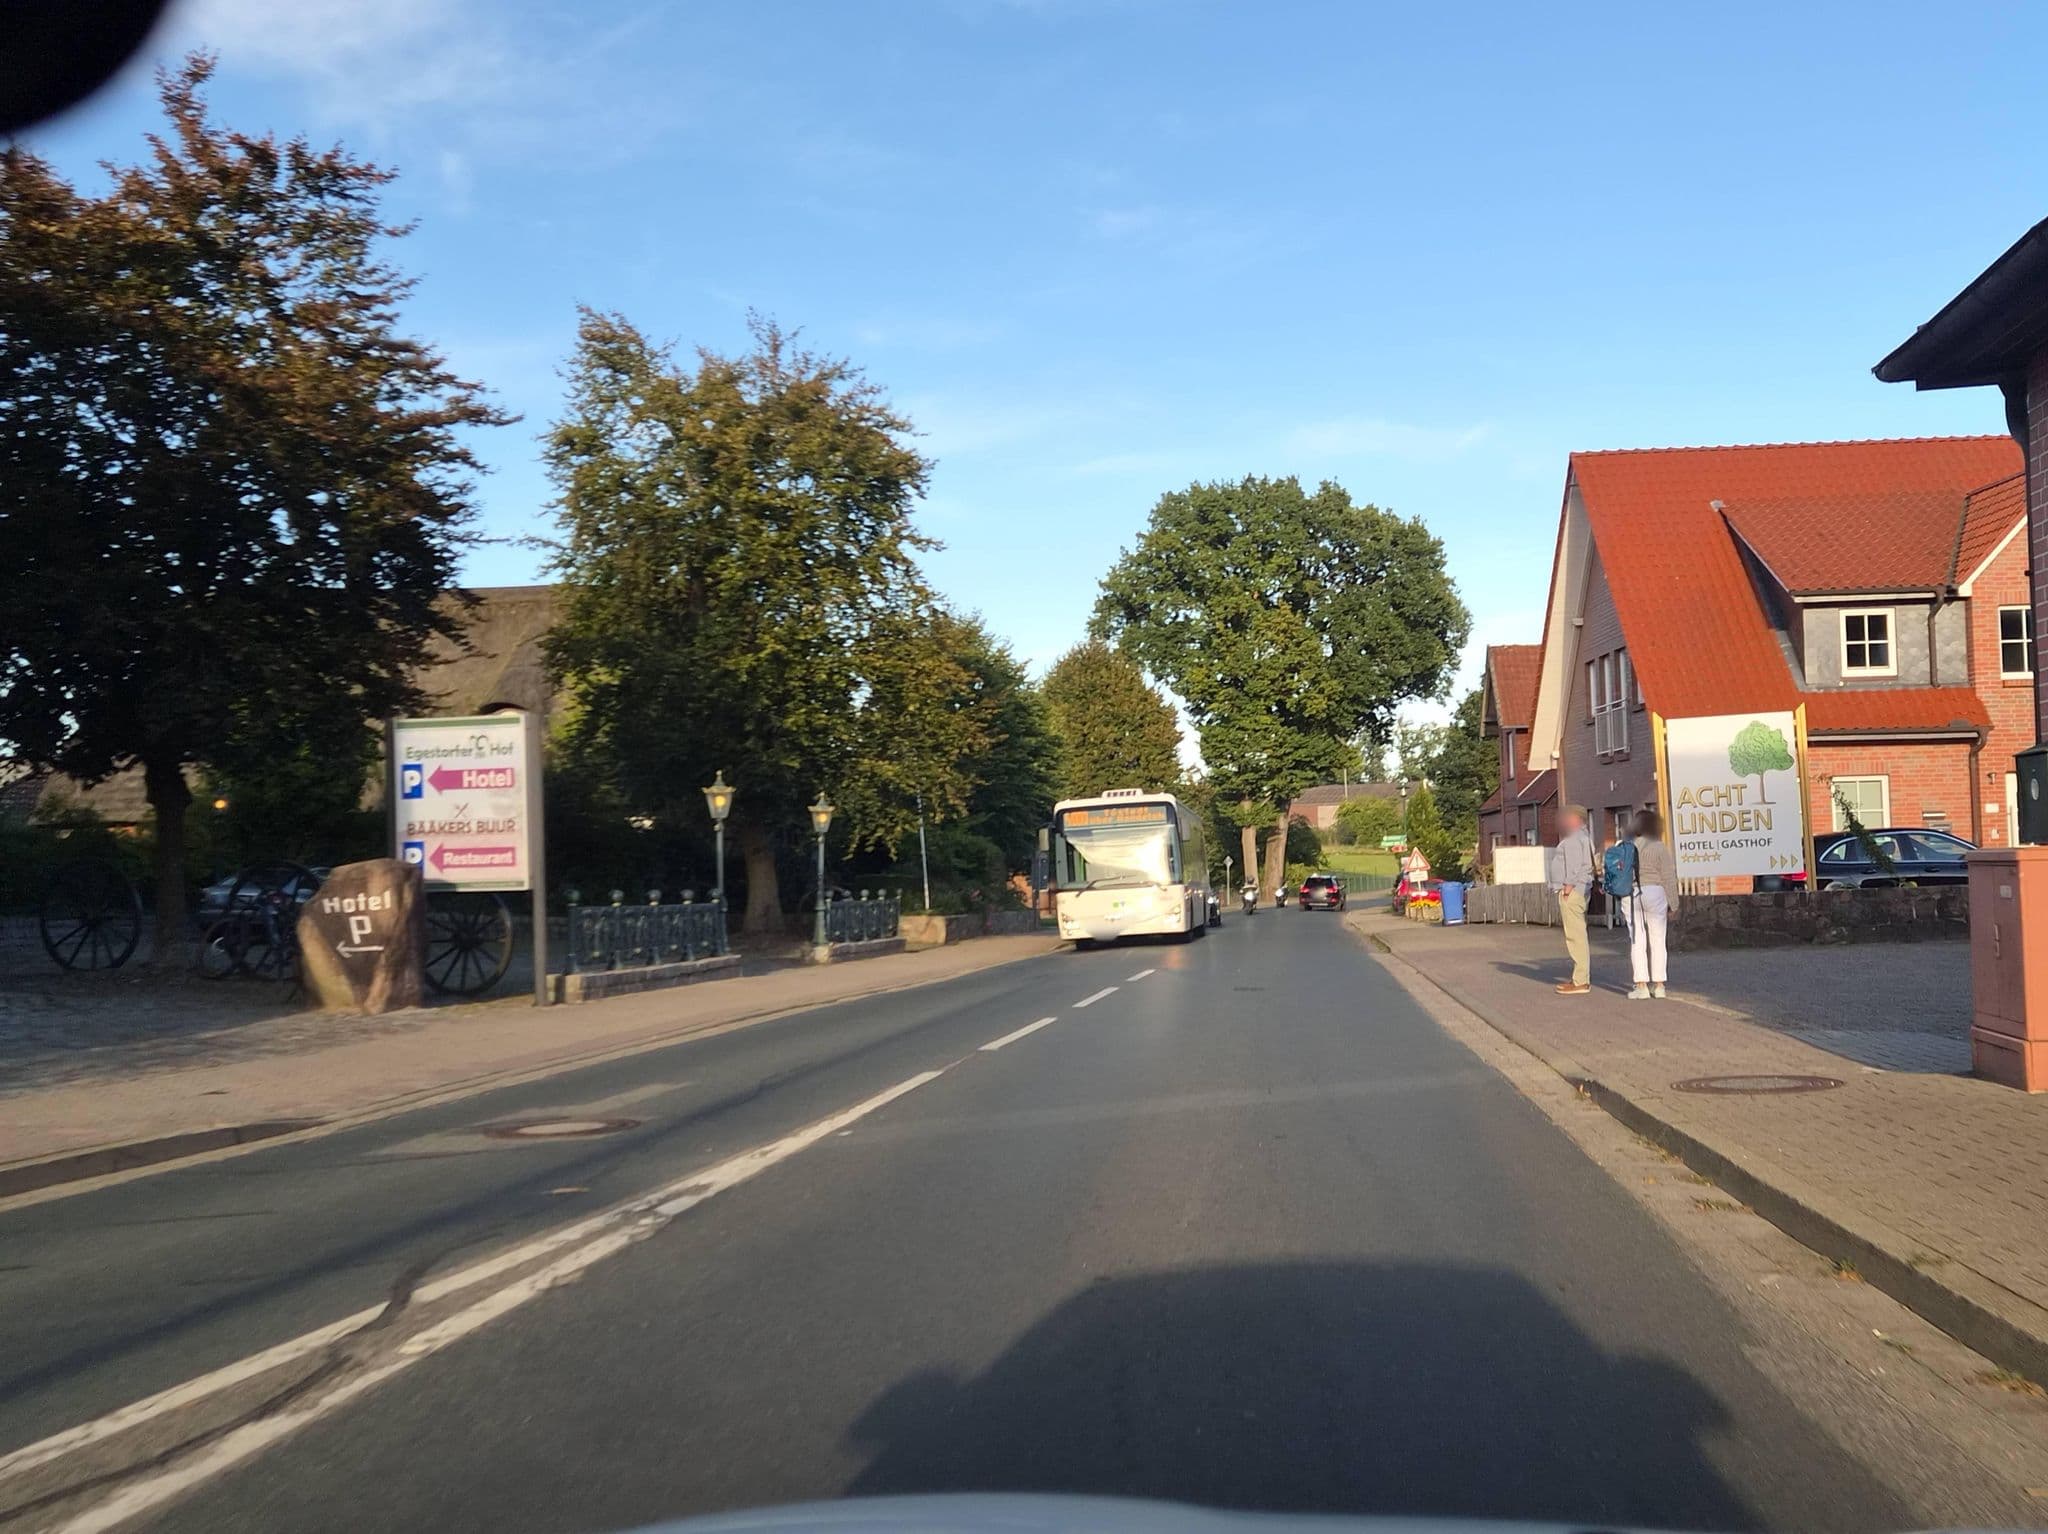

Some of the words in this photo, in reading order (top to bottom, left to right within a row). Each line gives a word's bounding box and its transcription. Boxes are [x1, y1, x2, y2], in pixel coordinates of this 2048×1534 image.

[406, 744, 472, 760] Egestorfer
[490, 742, 513, 756] Hof
[403, 769, 421, 793] P
[462, 769, 512, 788] Hotel
[1677, 784, 1747, 809] ACHT
[477, 819, 516, 834] BUUR
[1678, 808, 1773, 835] LINDEN
[1679, 840, 1714, 851] HOTEL
[1721, 837, 1773, 849] GASTHOF
[443, 852, 513, 866] Restaurant
[323, 890, 392, 914] Hotel
[349, 915, 372, 945] P
